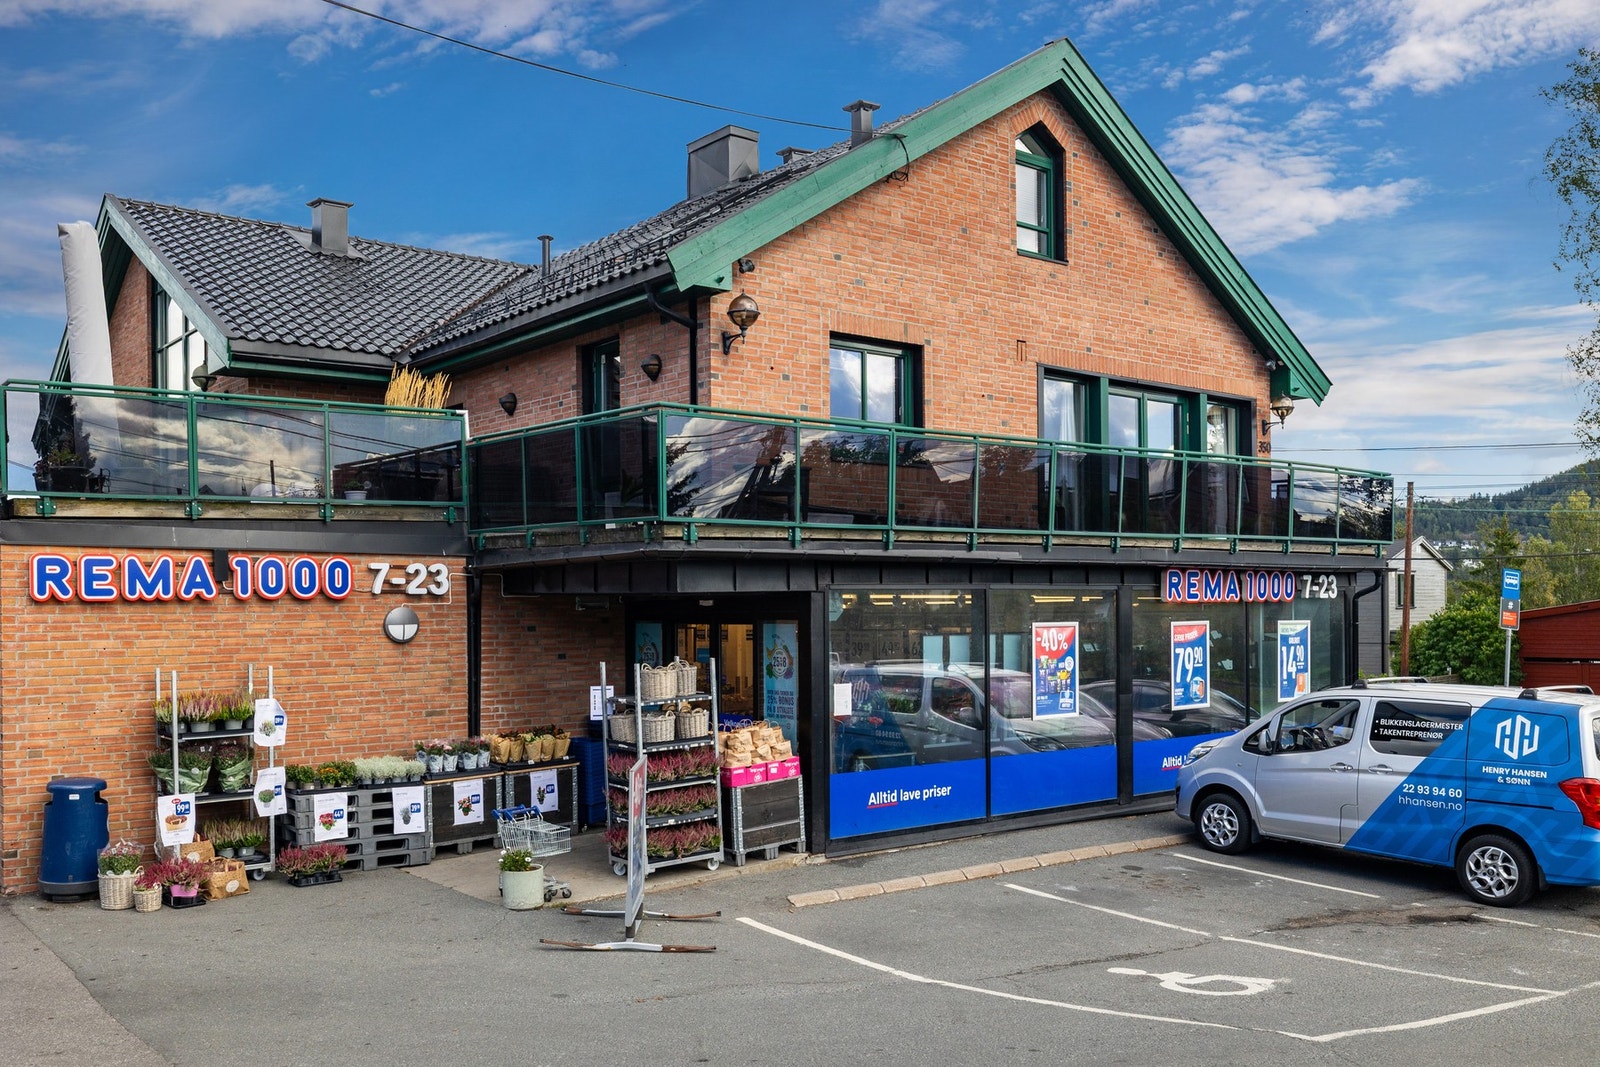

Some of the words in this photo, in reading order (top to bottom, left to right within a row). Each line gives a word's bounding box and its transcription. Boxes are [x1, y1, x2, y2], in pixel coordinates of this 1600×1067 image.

[29, 552, 219, 601] REMA
[229, 553, 354, 601] 1000
[367, 562, 449, 596] 7-23
[1164, 568, 1241, 603] REMA
[1246, 570, 1297, 603] 1000
[1302, 574, 1338, 599] 7-23
[1036, 628, 1068, 652] -40%
[1380, 718, 1464, 730] BLIKKENSLAGERMESTER
[1379, 728, 1444, 739] TAKENTREPRENØR
[1162, 755, 1182, 768] Alltid
[1482, 766, 1510, 775] HENRY
[1511, 768, 1548, 779] HANSEN
[1497, 776, 1505, 784] &
[1505, 776, 1531, 786] SØNN
[868, 789, 898, 806] Alltid
[900, 788, 921, 802] lave
[922, 784, 952, 801] priser
[1402, 783, 1415, 793] 22
[1417, 785, 1430, 795] 93
[1432, 787, 1446, 797] 94
[1448, 788, 1462, 798] 60
[1398, 795, 1463, 811] hhansen.no
